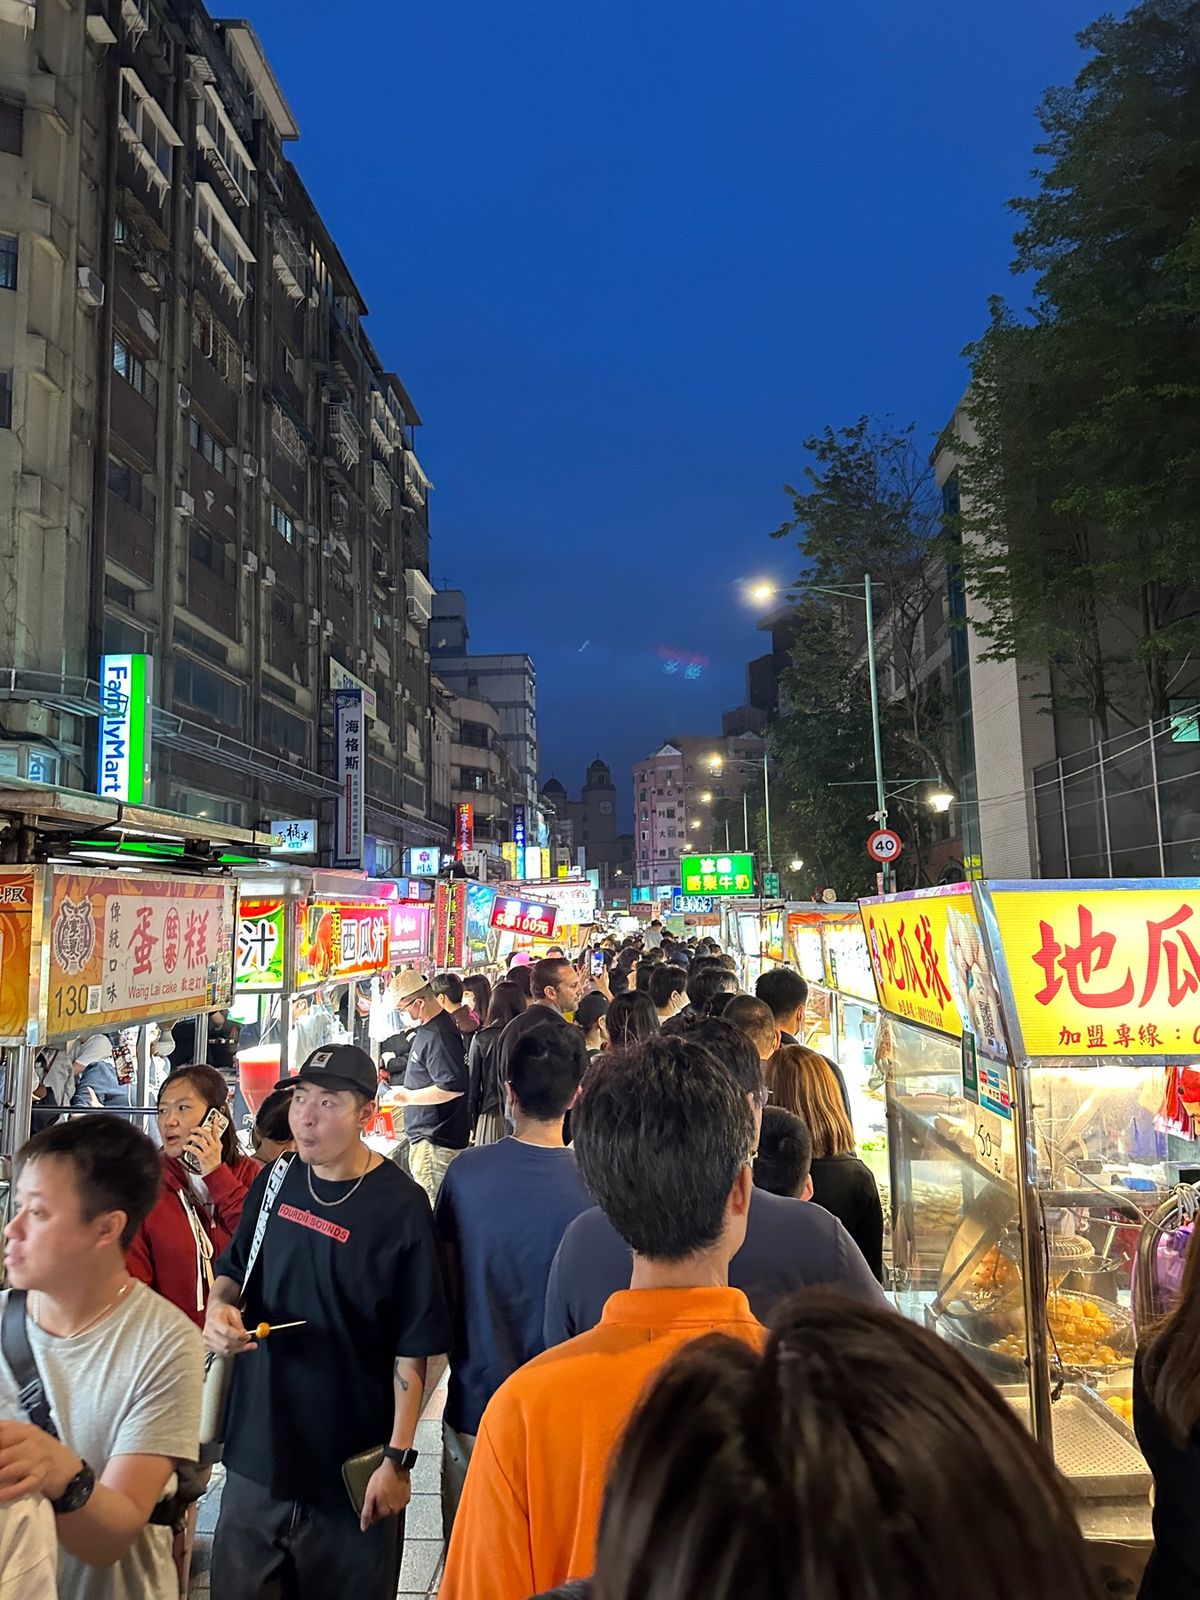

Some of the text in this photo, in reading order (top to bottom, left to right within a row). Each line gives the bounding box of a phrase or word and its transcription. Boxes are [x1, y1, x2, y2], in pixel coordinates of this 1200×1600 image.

[104, 667, 127, 792] FamilyMart
[345, 720, 359, 770] 海格斯
[875, 840, 894, 851] 40
[0, 886, 26, 903] 限
[687, 874, 750, 891] 酪梨牛奶
[106, 902, 121, 1004] 傳統口味
[239, 922, 275, 967] 汁
[342, 916, 388, 963] 西瓜汁
[1031, 903, 1200, 1008] 地瓜
[879, 914, 952, 1011] 地瓜球
[55, 984, 89, 1018] 130
[128, 982, 178, 1000] Wang Lai cake
[974, 1124, 992, 1157] 50
[309, 1216, 348, 1240] SOUNDS
